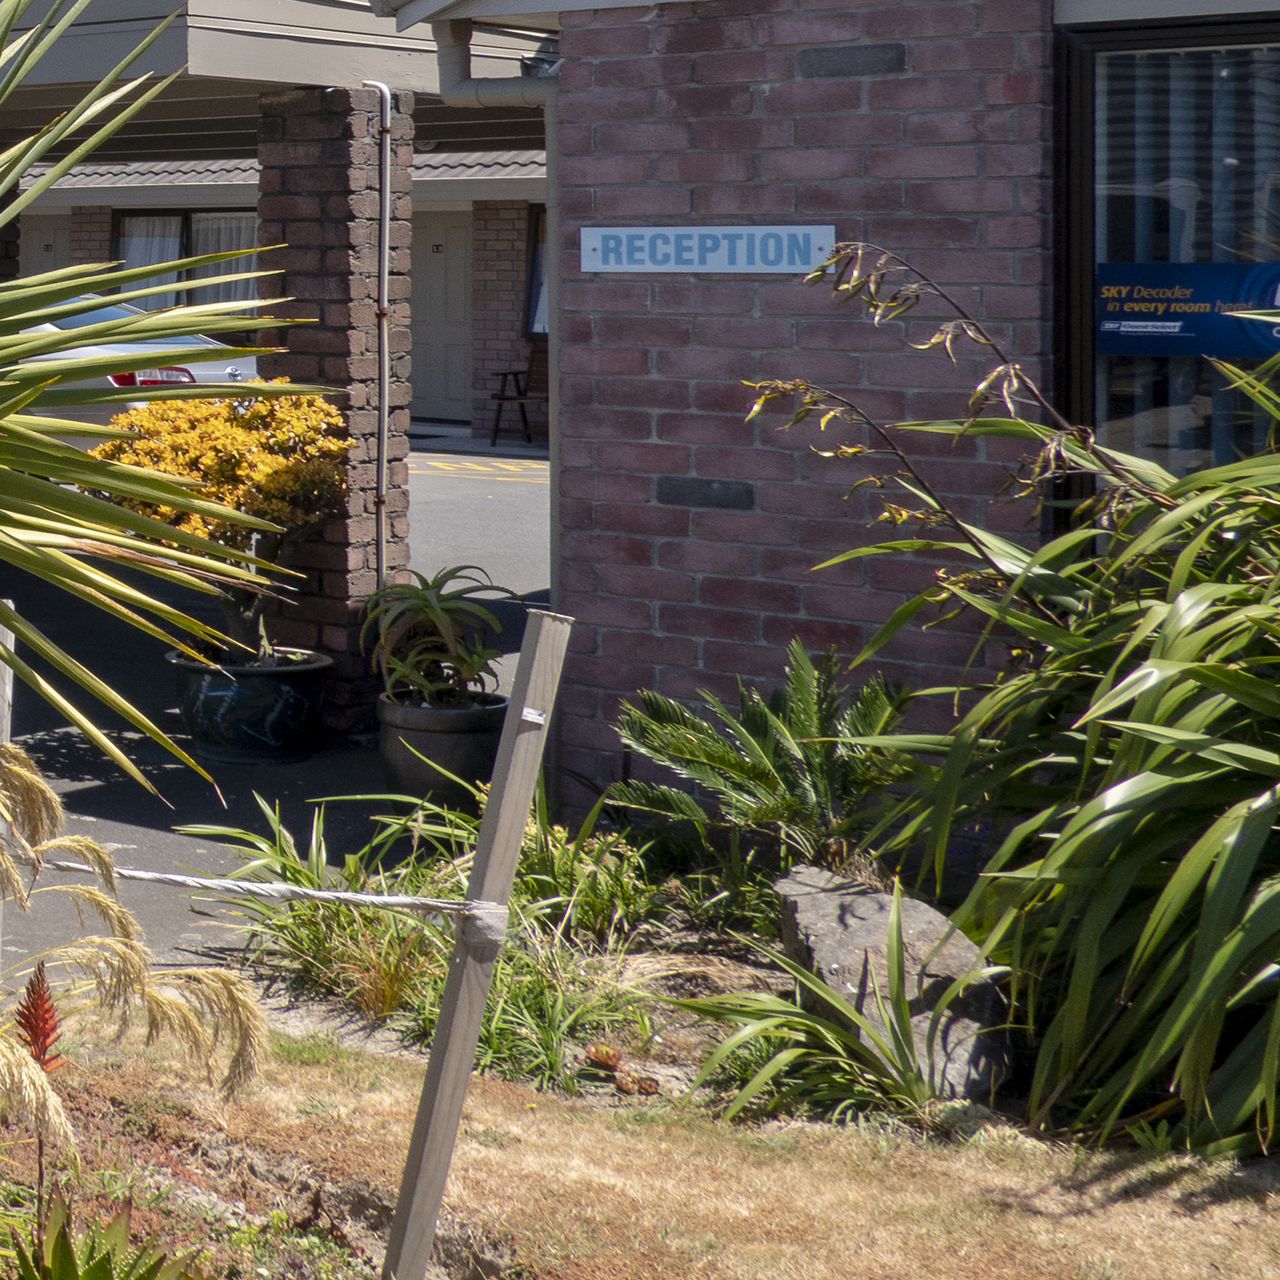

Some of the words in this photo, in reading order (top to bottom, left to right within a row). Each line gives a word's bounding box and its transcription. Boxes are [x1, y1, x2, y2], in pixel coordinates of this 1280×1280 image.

[601, 232, 812, 267] RECEPTION
[1100, 286, 1131, 298] SKY
[1133, 285, 1194, 298] Decoder
[1107, 300, 1120, 312] in
[1123, 301, 1168, 315] every
[1170, 302, 1211, 313] room
